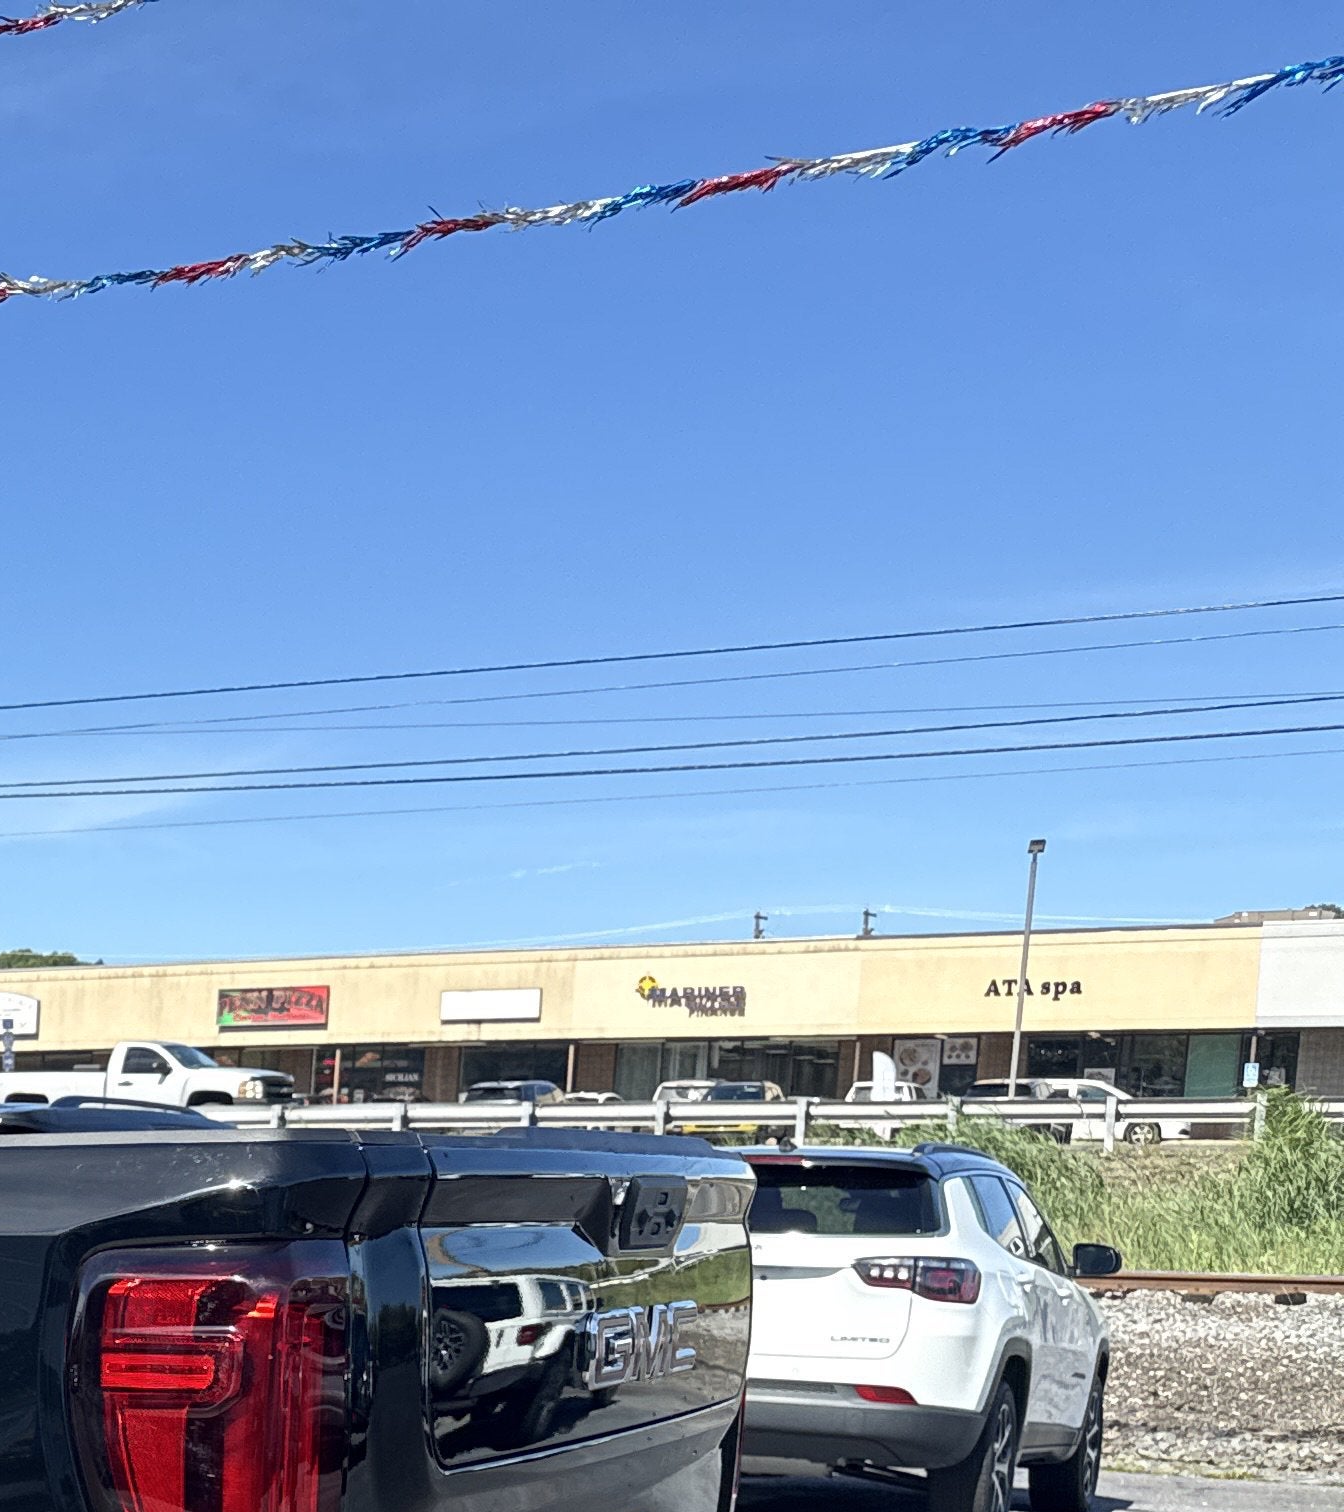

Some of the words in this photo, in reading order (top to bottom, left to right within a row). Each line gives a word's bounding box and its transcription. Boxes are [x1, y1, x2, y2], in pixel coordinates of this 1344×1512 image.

[647, 986, 747, 1005] MARINER
[1040, 980, 1083, 1002] spa
[583, 1300, 699, 1392] GMC
